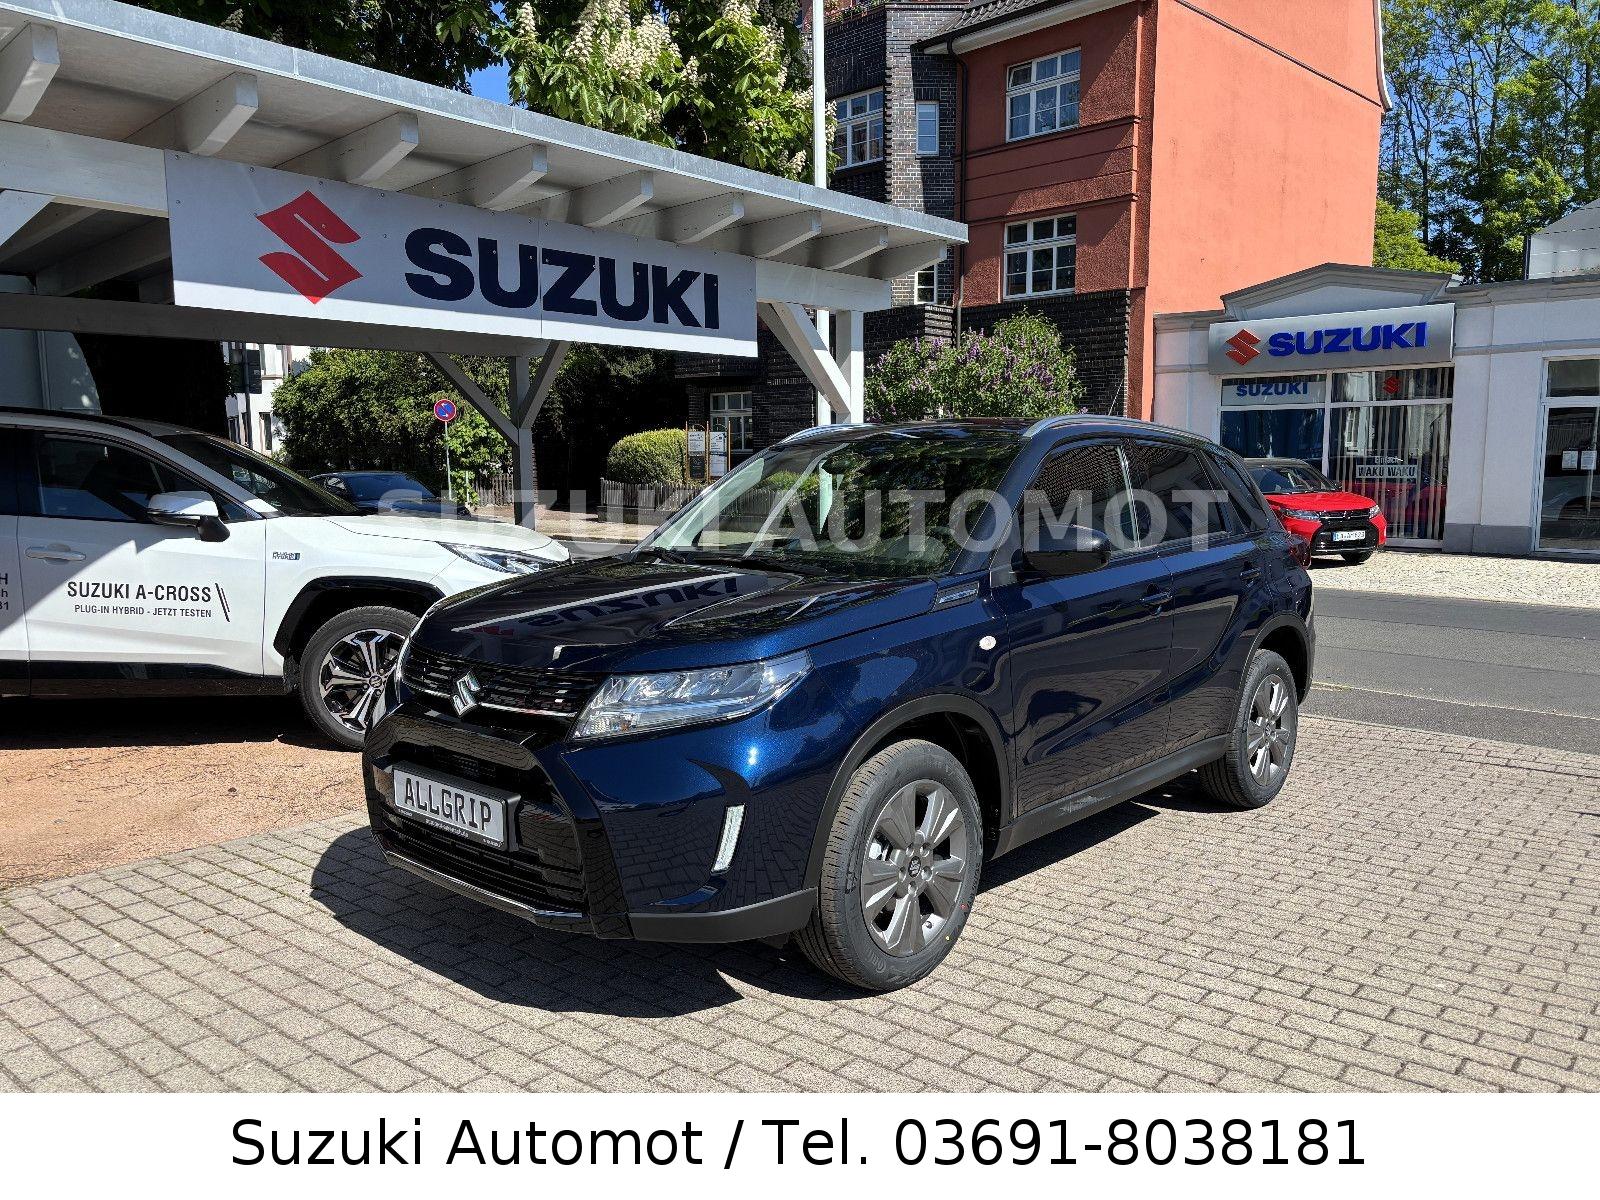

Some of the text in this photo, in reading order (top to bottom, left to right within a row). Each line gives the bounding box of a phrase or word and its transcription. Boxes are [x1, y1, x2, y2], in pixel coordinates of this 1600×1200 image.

[404, 227, 720, 330] SUZUKI
[1268, 322, 1428, 357] SUZUKI
[1236, 381, 1308, 397] SUZUKI
[1358, 466, 1384, 477] WAKU
[67, 581, 212, 603] SUZUKI A-CROSS
[74, 604, 110, 614] PLUG-IN
[112, 605, 145, 616] HYBRID
[152, 607, 177, 617] JETZT
[180, 608, 212, 618] TESTEN
[404, 777, 492, 832] ALLGRIP
